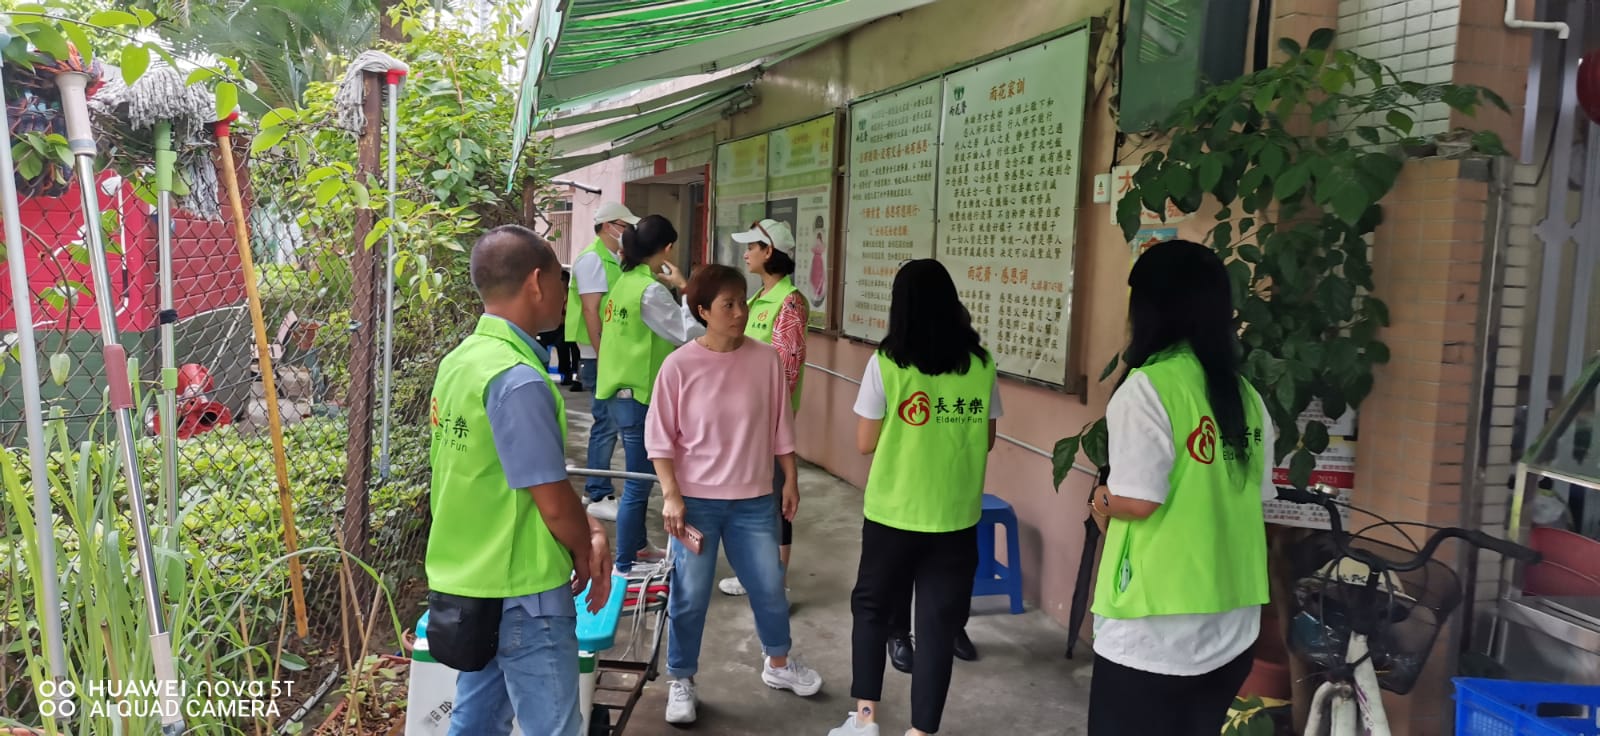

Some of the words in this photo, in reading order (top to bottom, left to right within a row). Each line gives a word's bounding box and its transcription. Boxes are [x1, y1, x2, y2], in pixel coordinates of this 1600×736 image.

[934, 396, 985, 415] 長者樂
[935, 416, 966, 425] Elderly
[967, 416, 984, 424] Fun
